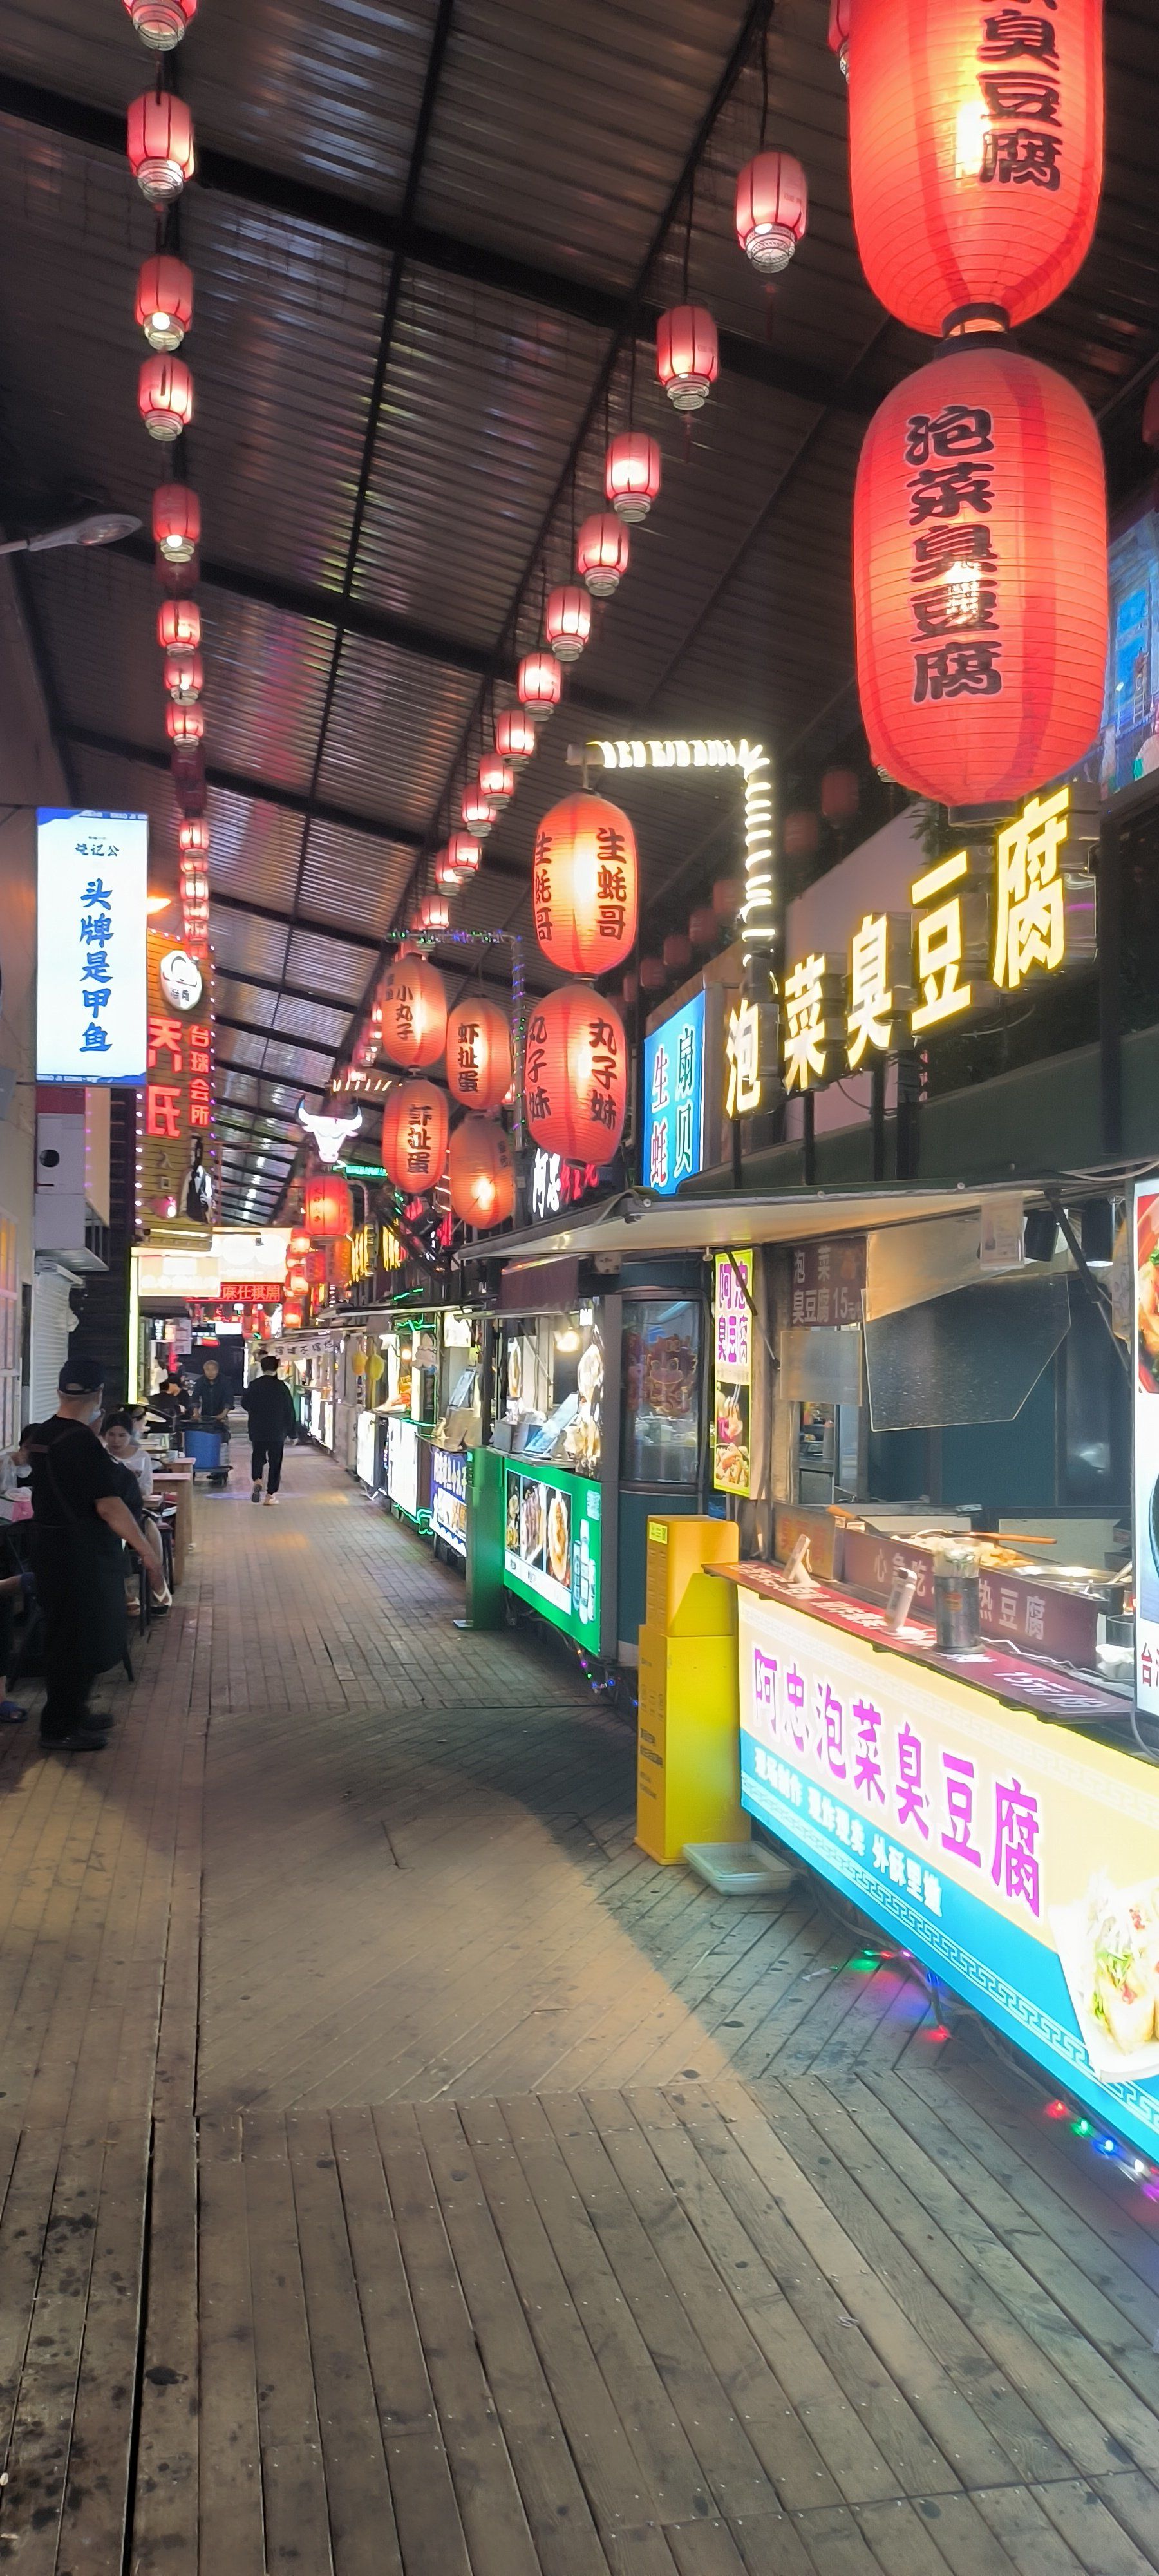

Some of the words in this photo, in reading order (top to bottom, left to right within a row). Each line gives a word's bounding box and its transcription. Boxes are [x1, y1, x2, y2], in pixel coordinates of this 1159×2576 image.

[976, 0, 1063, 191] 臭豆腐
[905, 405, 1002, 703] 泡菜臭豆腐
[535, 831, 553, 942] 生蚝哥
[596, 828, 627, 941] 生蚝哥
[79, 878, 114, 1052] 头牌是甲鱼
[724, 785, 1069, 1119] 泡菜臭豆腐
[396, 985, 414, 1041] 小丸子
[457, 1023, 480, 1094] 虾扯蛋
[189, 1025, 210, 1126] 台球会所
[527, 1016, 552, 1123] 丸子妹
[589, 1017, 617, 1130] 丸子妹
[651, 1046, 669, 1187] 生蚝
[676, 1026, 694, 1175] 扇贝
[719, 1260, 748, 1309] 阿忠
[793, 1287, 831, 1324] 臭豆腐
[794, 1245, 831, 1283] 泡菜
[718, 1315, 748, 1364] 臭豆腐
[874, 1548, 1046, 1642] 心急吃热豆腐
[754, 1647, 1041, 1918] 阿忠泡菜臭豆腐
